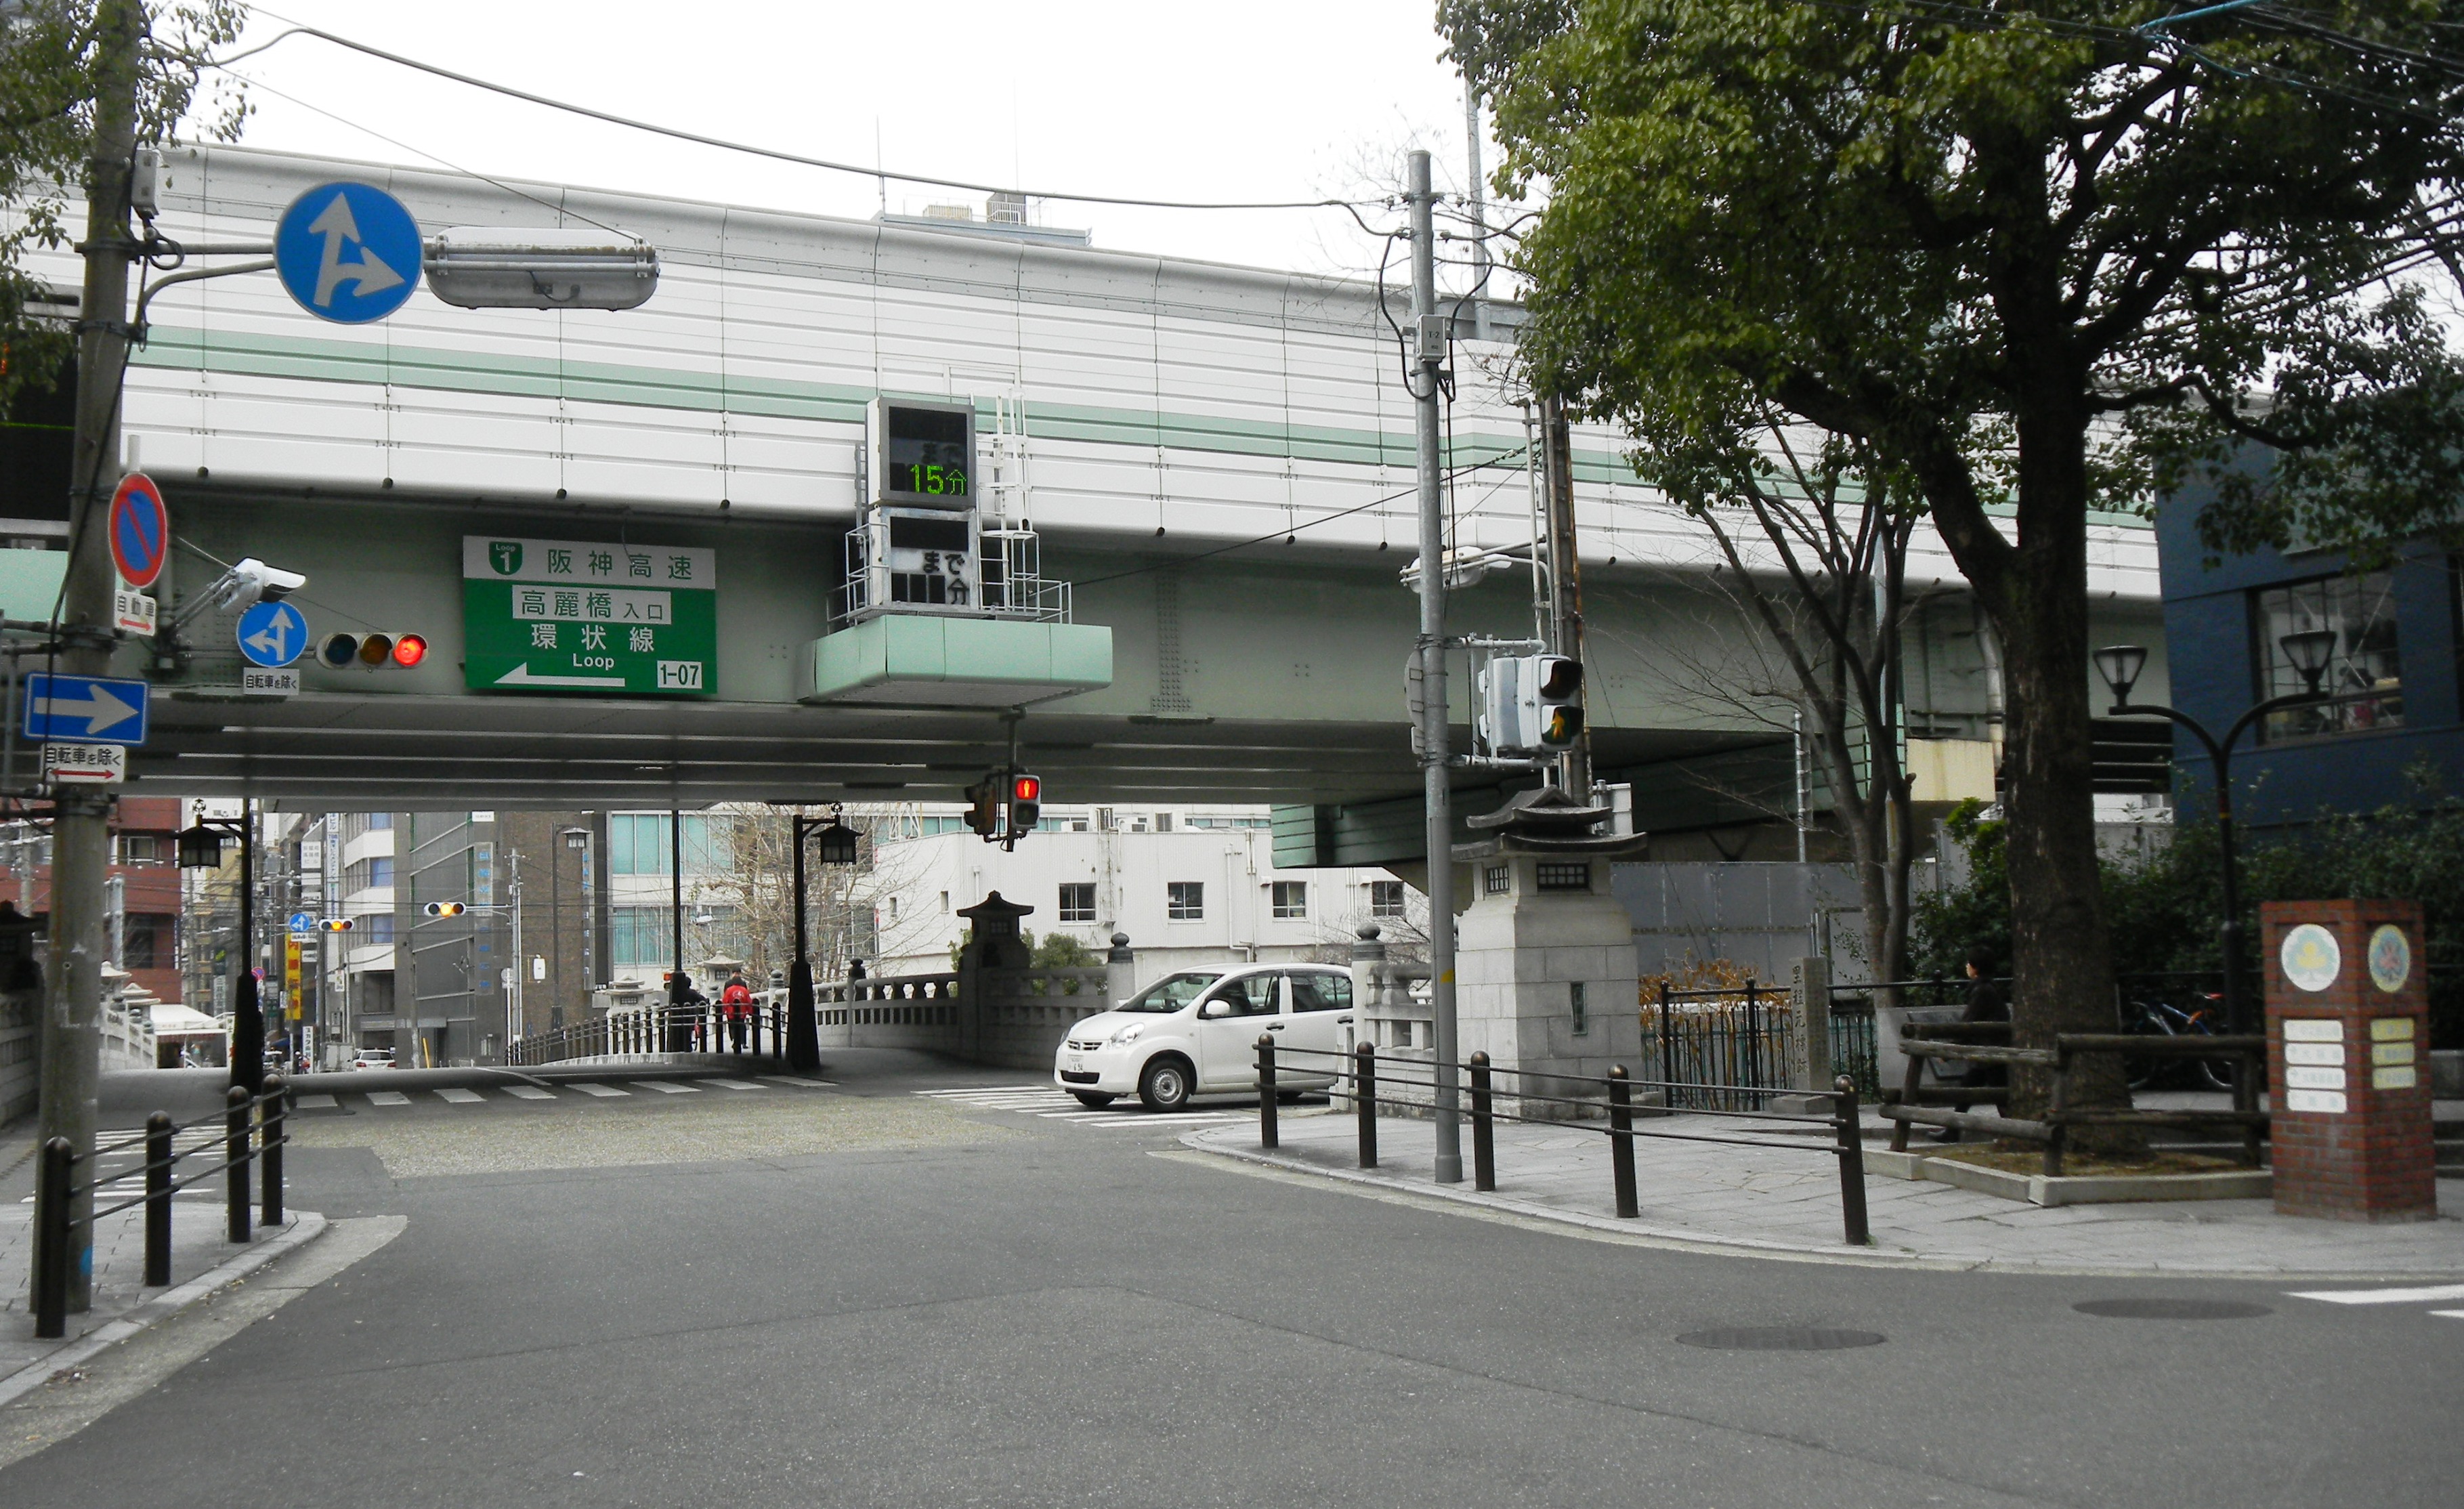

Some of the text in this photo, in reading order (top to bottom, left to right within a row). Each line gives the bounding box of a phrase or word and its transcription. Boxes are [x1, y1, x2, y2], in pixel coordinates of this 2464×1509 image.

[910, 463, 967, 496] 15分
[496, 544, 516, 552] Loop
[500, 551, 511, 572] 1
[547, 549, 692, 580] 阪神高速
[922, 551, 966, 575] まで
[948, 578, 969, 605] 分
[521, 590, 663, 621] 高麗橋入口
[531, 624, 655, 653] 環状線
[572, 653, 615, 671] Loop
[247, 674, 297, 689] 自転車を除く
[660, 664, 699, 685] 1-07
[46, 747, 121, 766] 自転車を除く
